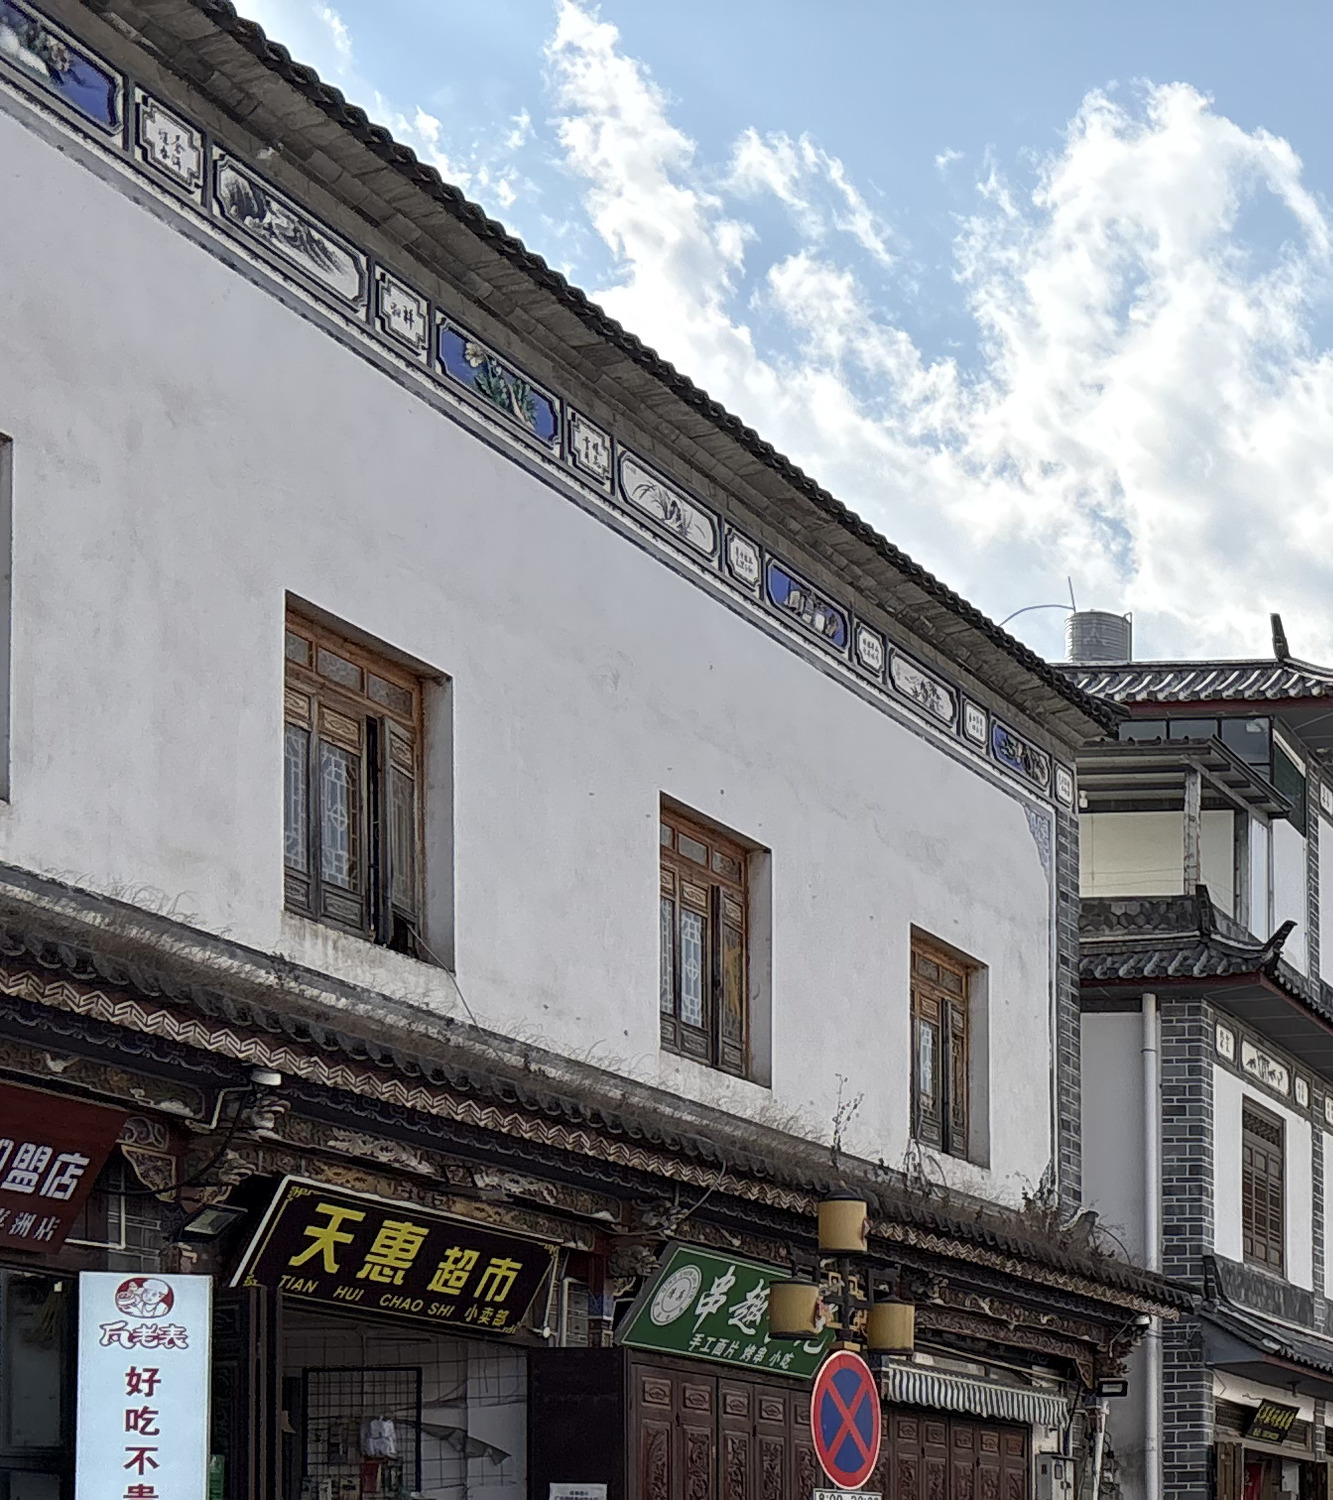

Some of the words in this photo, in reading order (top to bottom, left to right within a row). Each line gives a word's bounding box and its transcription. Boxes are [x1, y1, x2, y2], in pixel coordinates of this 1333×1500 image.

[277, 1274, 319, 1293] TIAN
[333, 1285, 365, 1302] HUI
[379, 1294, 424, 1313] CHAO
[427, 1302, 456, 1318] SHI
[464, 1303, 510, 1327] 小卖部
[688, 1333, 740, 1359] 手工面片
[769, 1349, 795, 1370] 小吃
